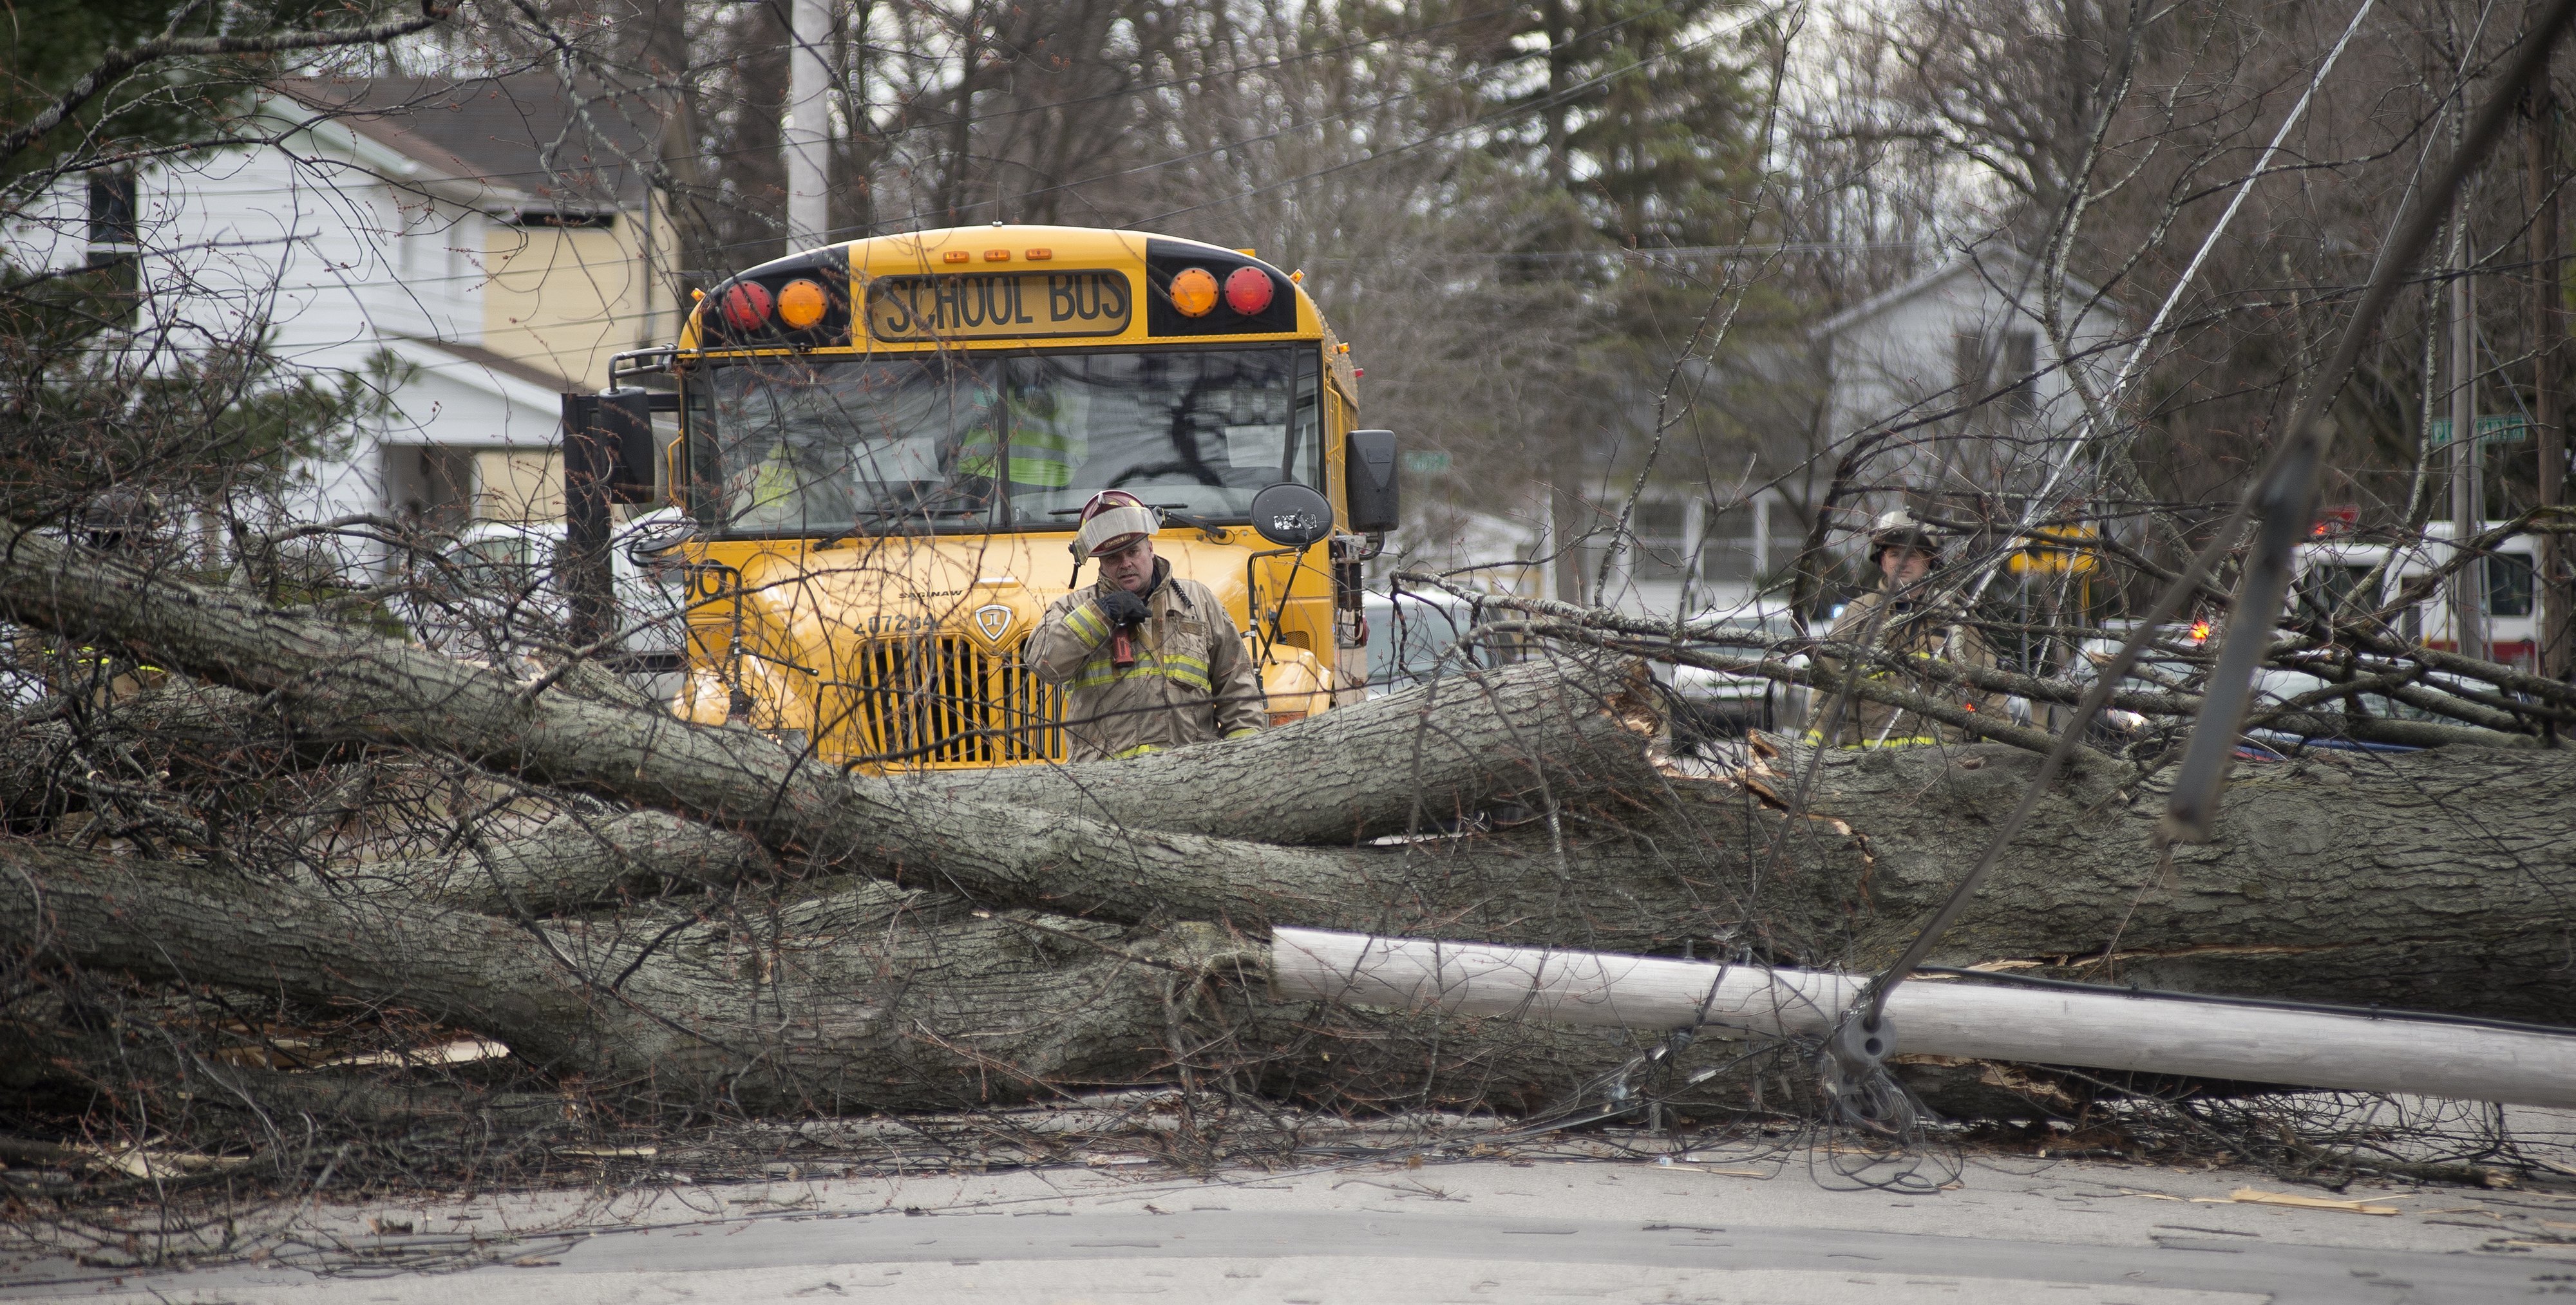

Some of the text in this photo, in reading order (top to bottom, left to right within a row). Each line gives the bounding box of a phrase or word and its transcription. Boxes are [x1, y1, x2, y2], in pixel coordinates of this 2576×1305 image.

[886, 274, 1126, 332] SCHOOL BUS
[899, 590, 963, 599] SAGINAW
